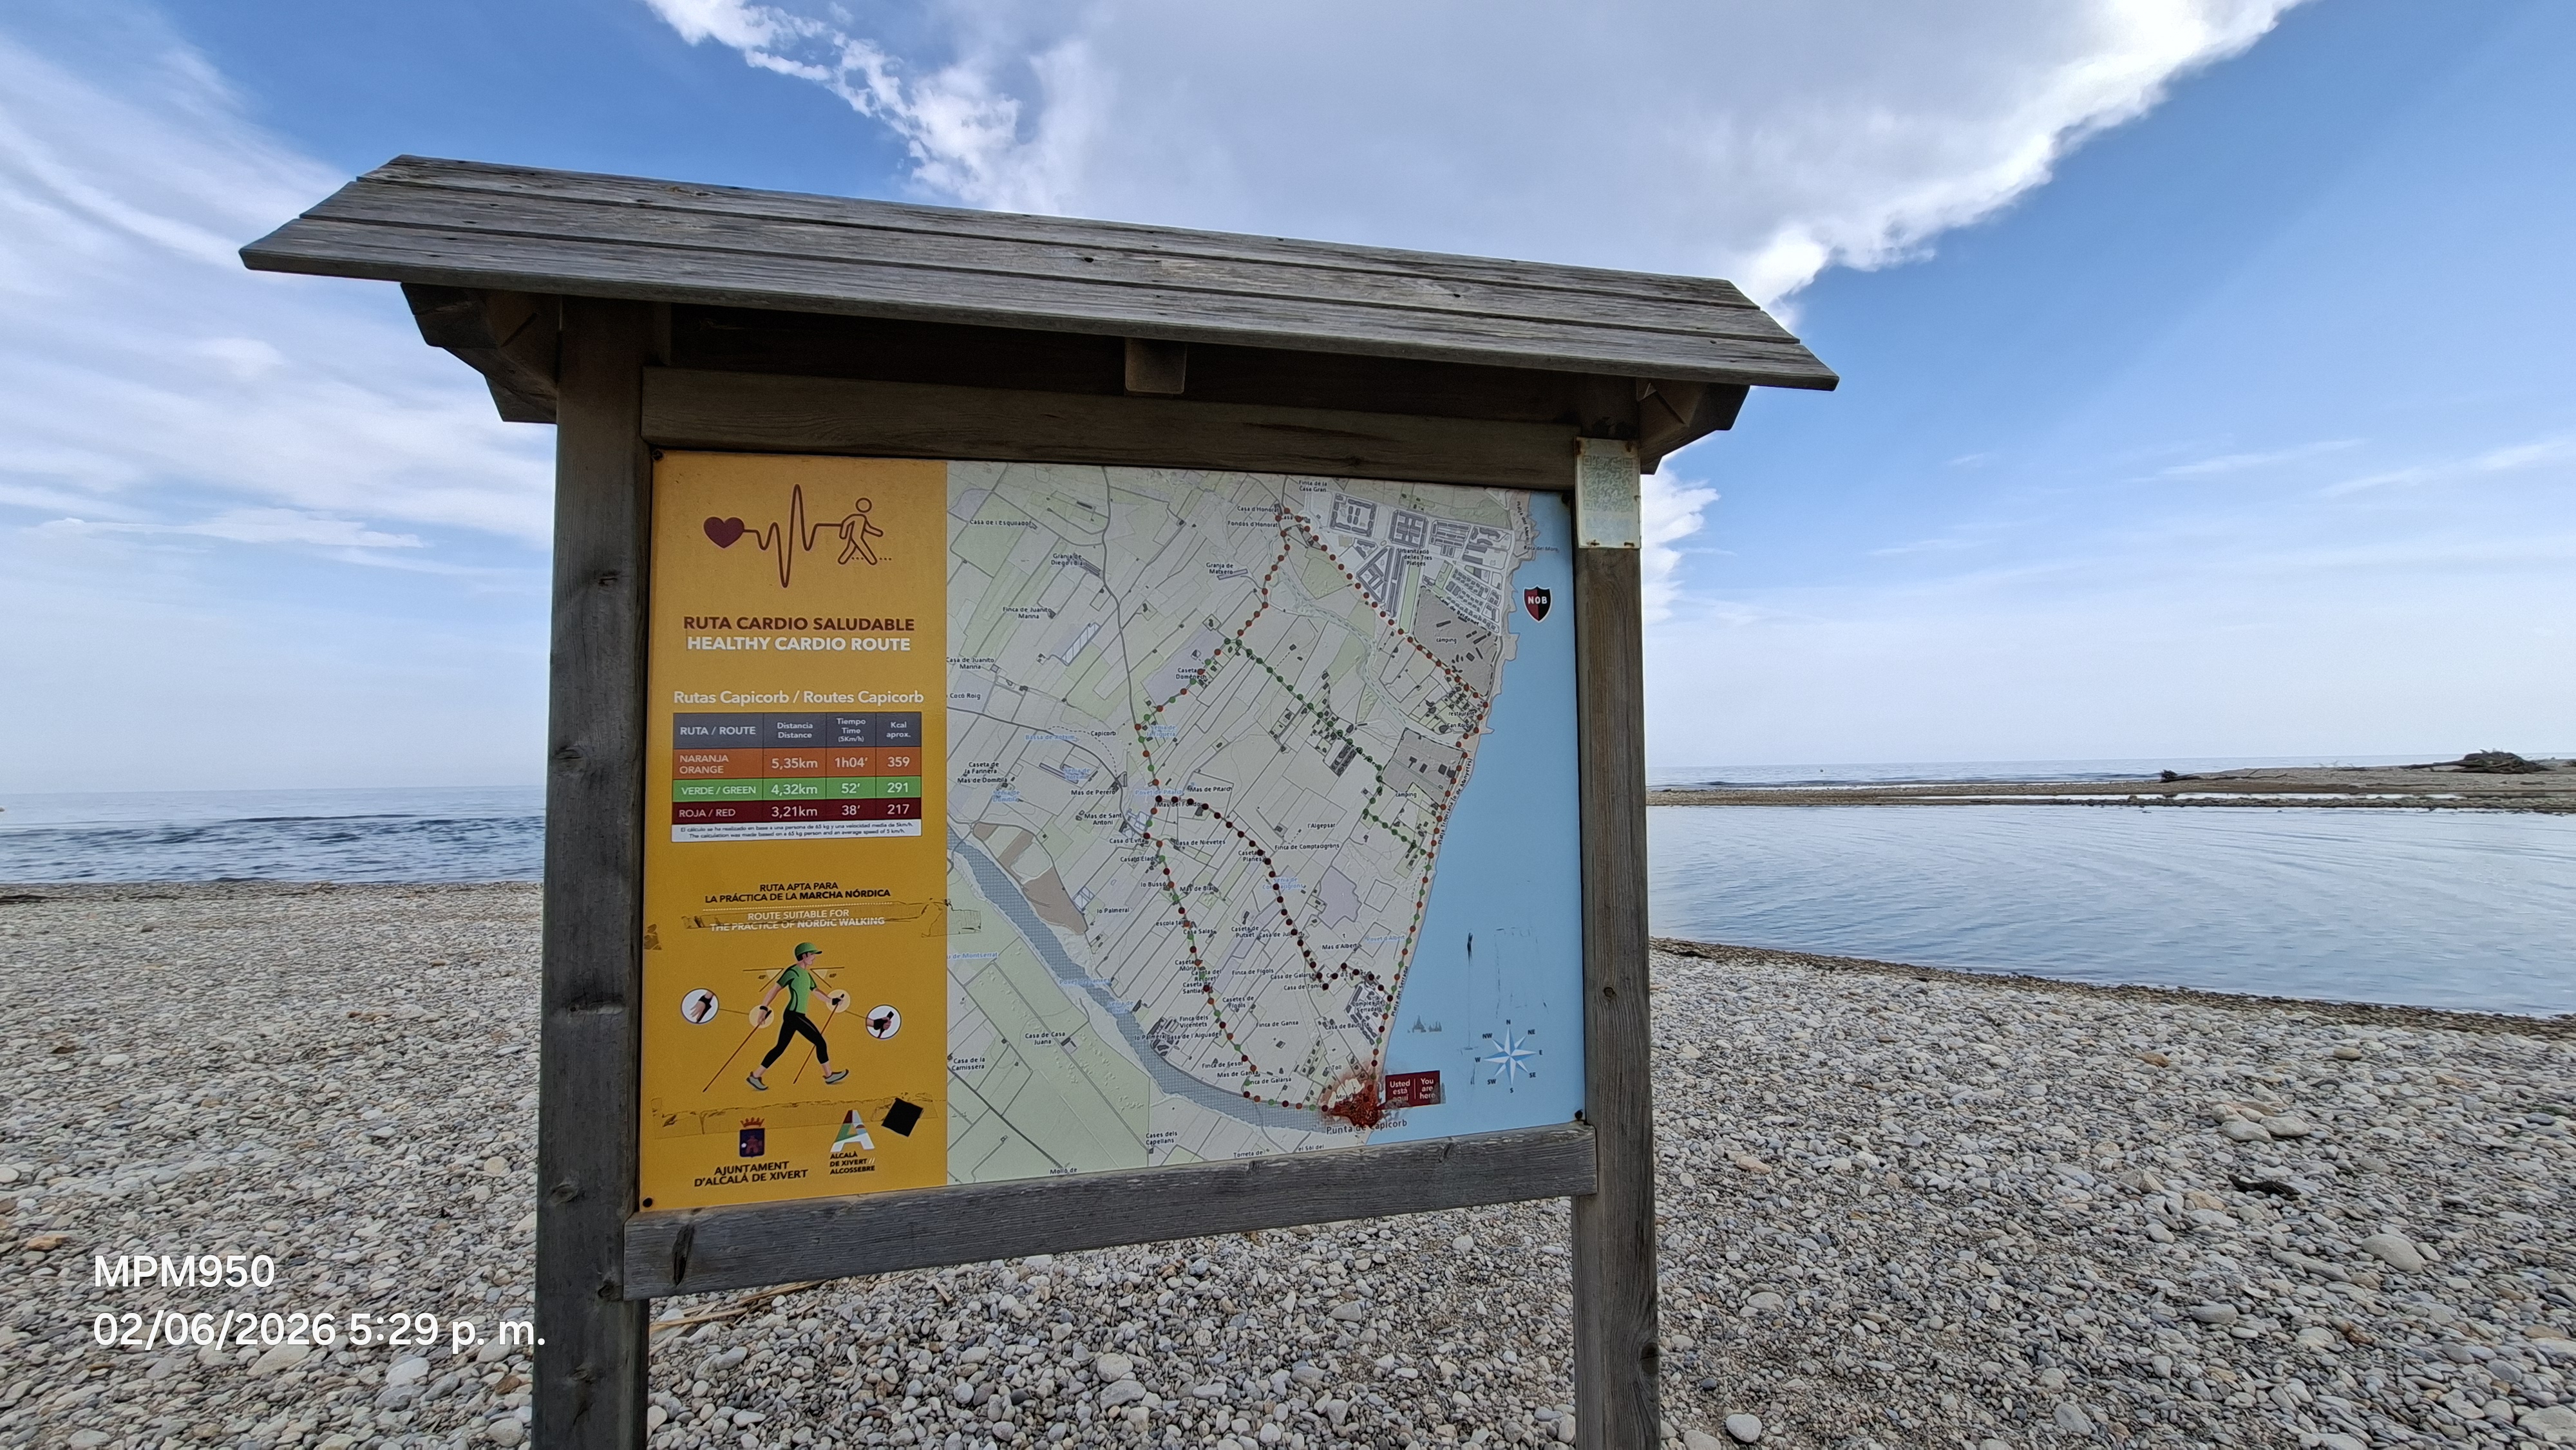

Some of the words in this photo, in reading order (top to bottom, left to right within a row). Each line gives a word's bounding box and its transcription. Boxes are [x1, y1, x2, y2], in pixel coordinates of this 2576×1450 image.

[1528, 596, 1547, 605] NOB
[684, 616, 732, 630] RUTA
[737, 617, 808, 630] CARDIO
[813, 618, 914, 631] SALUDABLE
[687, 637, 770, 650] HEALTHY
[774, 637, 846, 651] CARDIO
[851, 638, 910, 651] ROUTE
[674, 691, 715, 704] Rutas
[720, 691, 789, 706] Capicorb
[793, 691, 799, 704] /
[803, 692, 854, 704] Routes
[858, 691, 923, 706] Capicorb
[837, 718, 866, 727] Tiempo
[680, 726, 708, 735] RUTA
[711, 726, 715, 736] /
[718, 726, 755, 735] ROUTE
[772, 758, 817, 769] 5,35km
[887, 757, 910, 767] 359
[679, 765, 723, 774] ORANGE
[681, 786, 714, 795] VERDE
[716, 786, 720, 795] /
[723, 786, 756, 794] GREEN
[771, 784, 817, 796] 4,32km
[887, 782, 909, 793] 291
[679, 809, 706, 817] ROJA
[708, 808, 713, 817] /
[715, 808, 735, 816] RED
[772, 805, 817, 818] 3,21km
[887, 804, 909, 814] 217
[720, 892, 767, 902] PRÁCTICA
[800, 890, 842, 899] MARCHA
[846, 888, 891, 898] NÓRDICA
[783, 910, 827, 919] SUITABLE
[732, 922, 779, 930] PRACTICE
[782, 921, 795, 929] OF
[797, 919, 837, 928] NORDIC
[839, 917, 885, 926] WALKING
[1390, 1078, 1410, 1088] Usted
[1327, 1126, 1352, 1135] Punta
[1370, 1120, 1407, 1131] Capicorb
[714, 1162, 789, 1176] AJUNTAMENT
[830, 1165, 875, 1174] ALCOSSEBRE
[752, 1172, 766, 1182] DE
[770, 1169, 808, 1181] XIVERT
